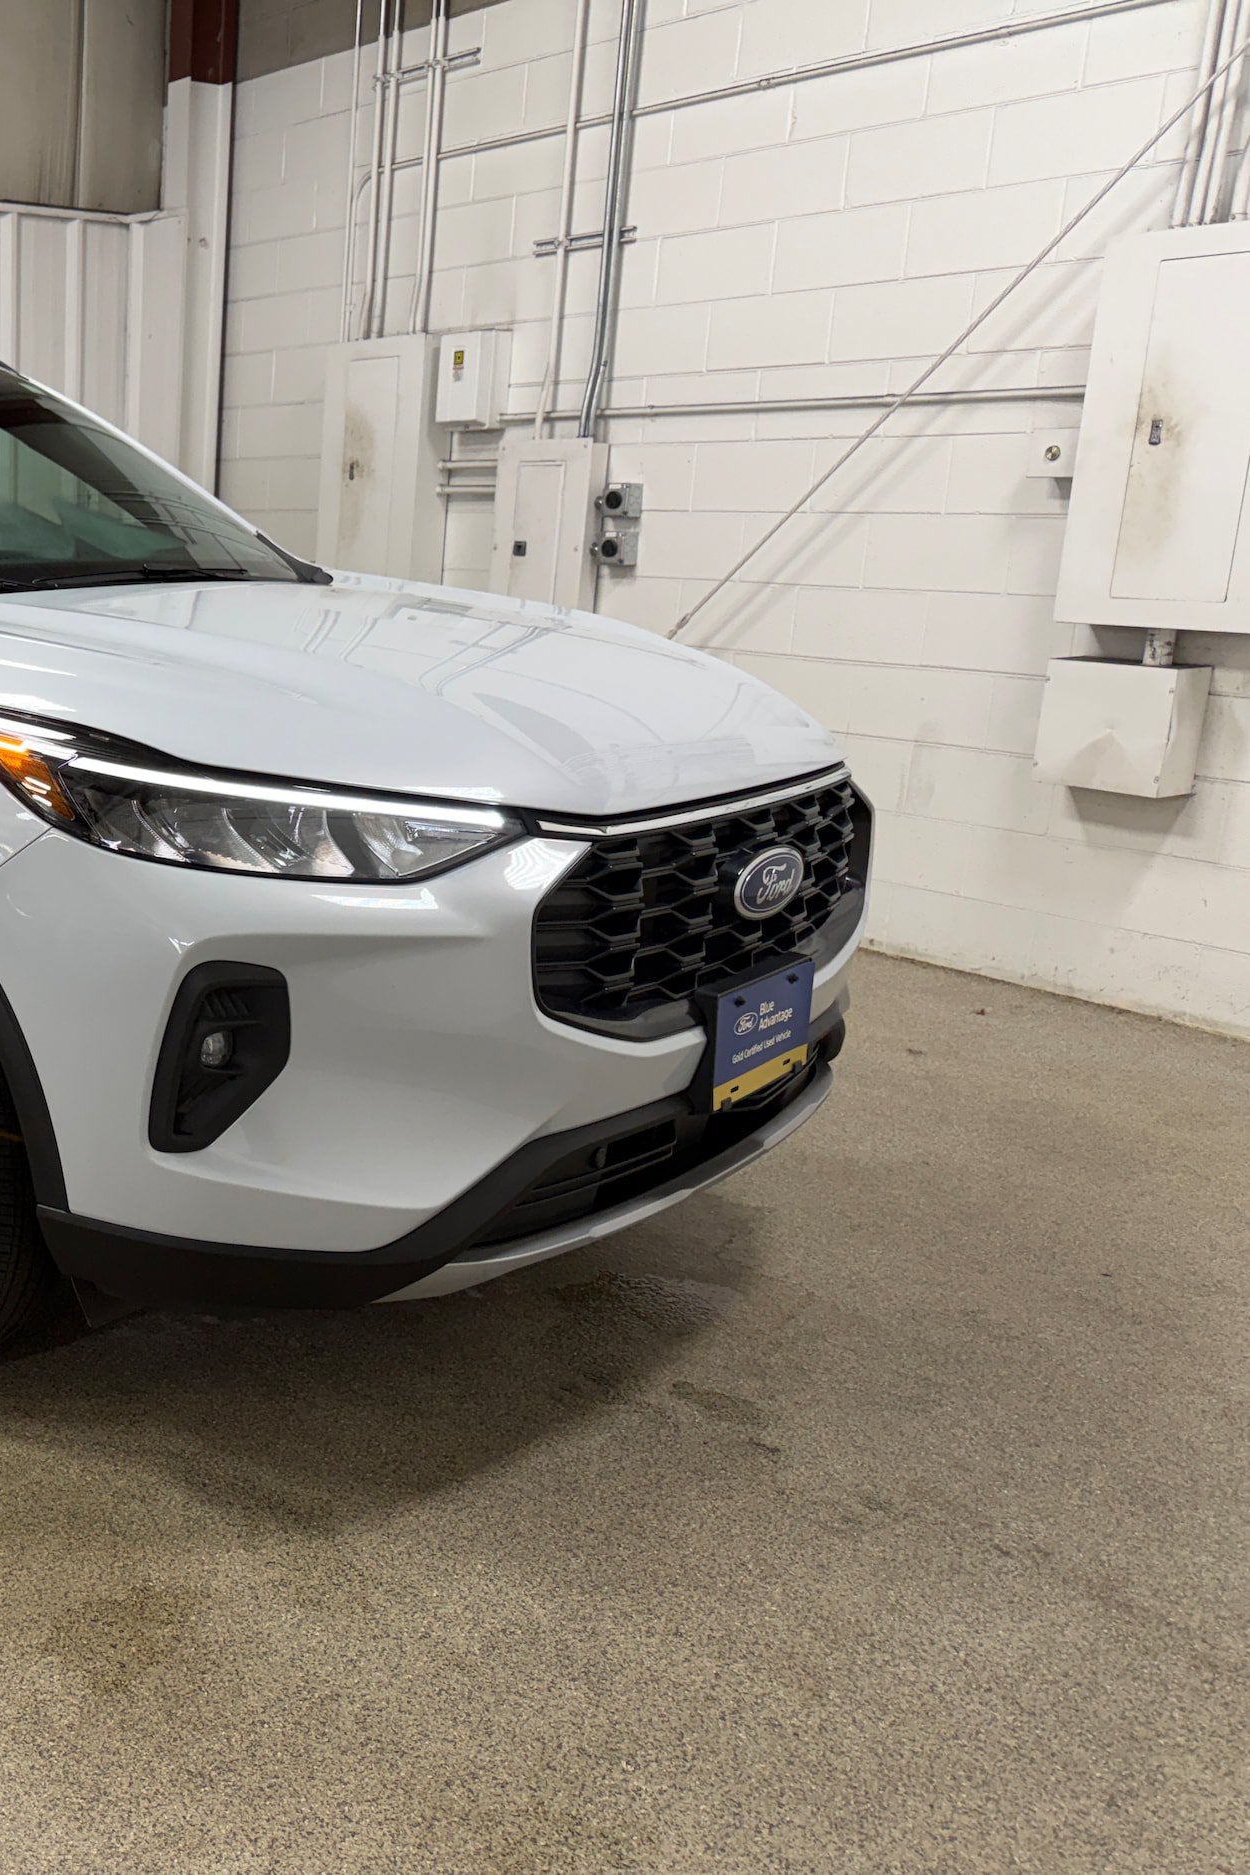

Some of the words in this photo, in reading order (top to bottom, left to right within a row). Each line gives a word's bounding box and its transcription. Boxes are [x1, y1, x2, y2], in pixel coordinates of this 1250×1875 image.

[757, 863, 795, 905] Ford
[758, 1008, 793, 1031] Advantage
[760, 1001, 774, 1016] Blue
[732, 1051, 744, 1064] Gold
[744, 1042, 763, 1057] Certified
[763, 1037, 775, 1049] Used
[775, 1030, 791, 1043] Vehicle
